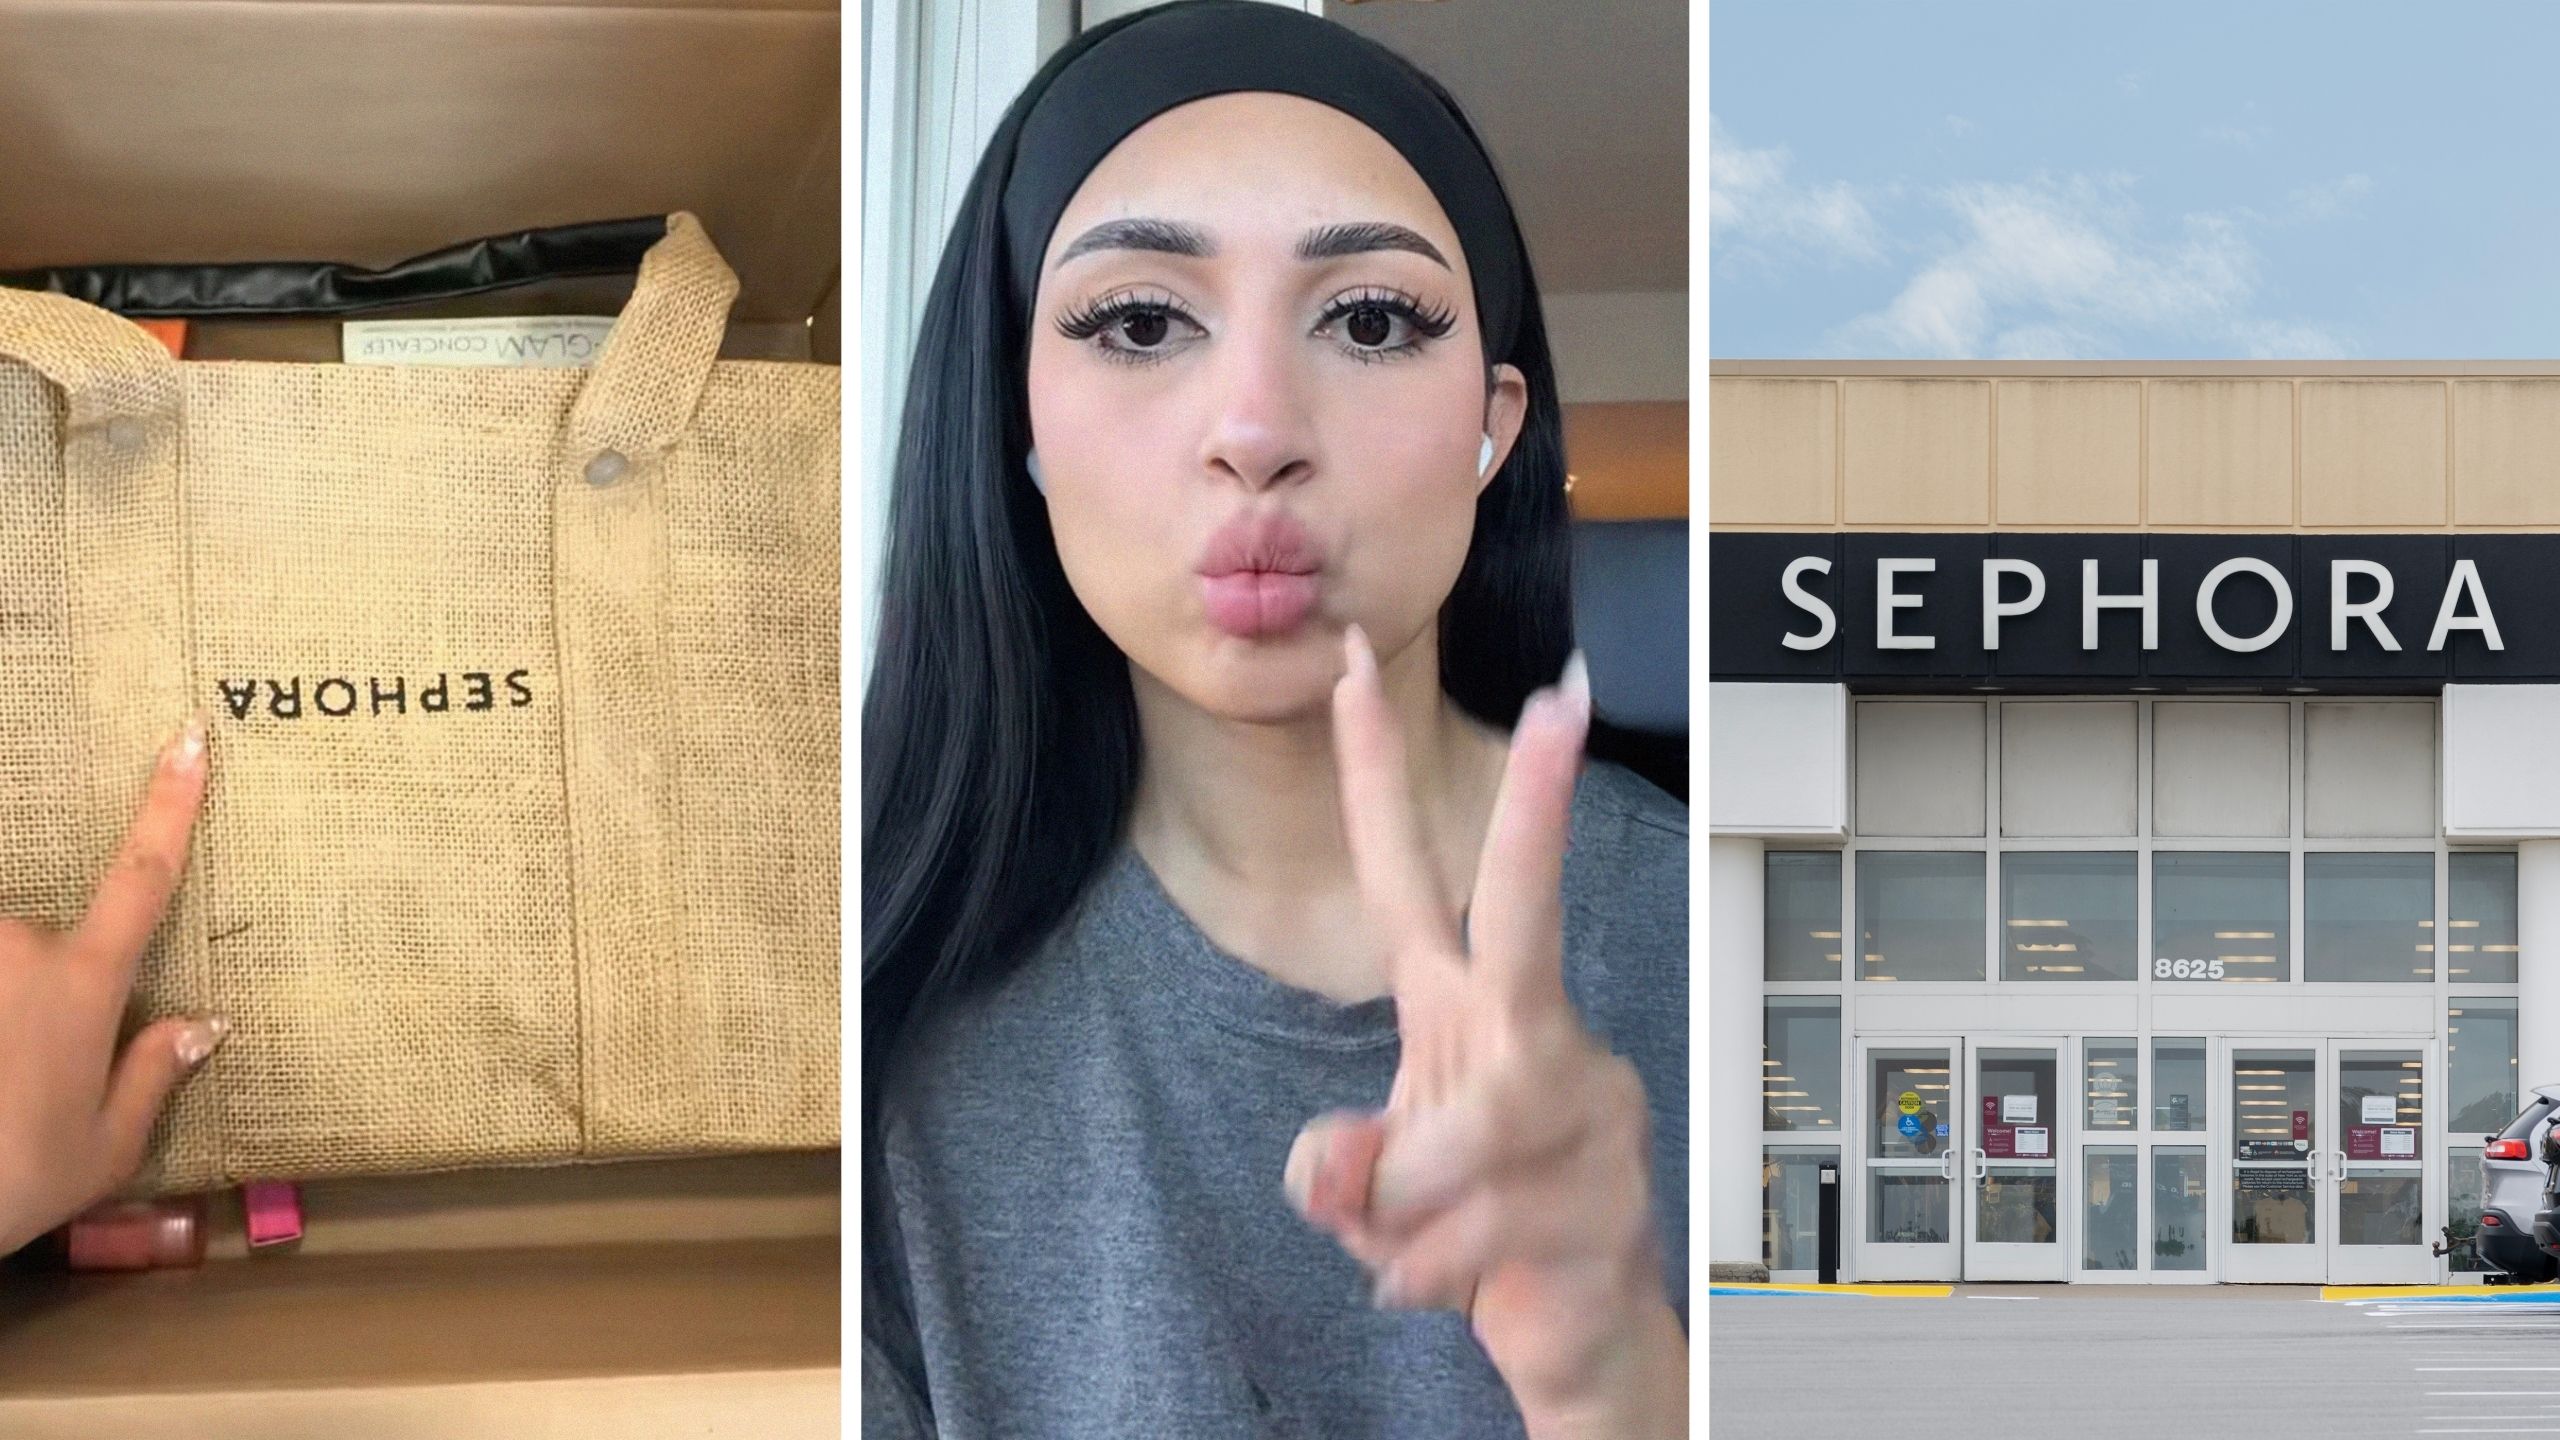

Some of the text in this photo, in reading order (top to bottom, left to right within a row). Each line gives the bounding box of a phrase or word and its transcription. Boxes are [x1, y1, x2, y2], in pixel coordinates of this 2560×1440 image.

[363, 336, 486, 355] CONCEALER
[1781, 556, 2505, 652] SEPHORA
[218, 669, 533, 720] SEPHORA
[2155, 958, 2224, 979] 8625
